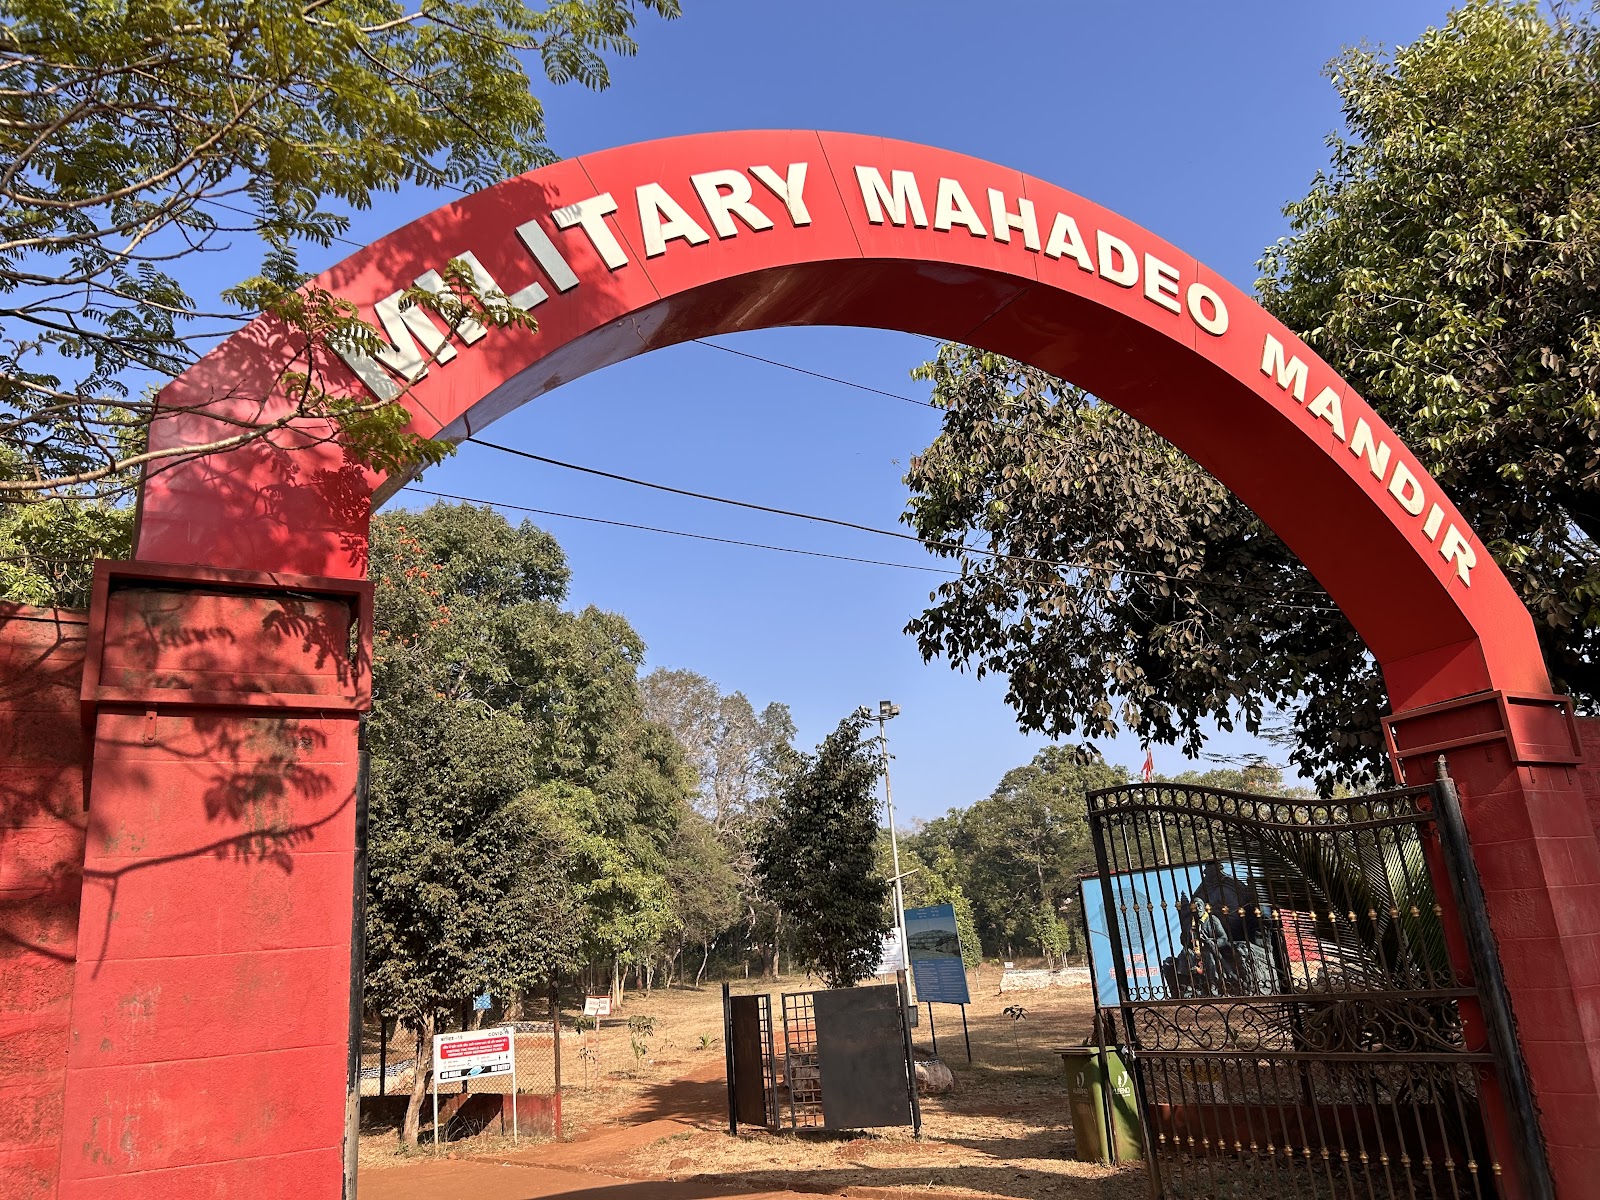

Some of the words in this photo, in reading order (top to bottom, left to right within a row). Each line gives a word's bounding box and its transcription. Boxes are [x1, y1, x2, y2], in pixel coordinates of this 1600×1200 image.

[326, 162, 812, 401] MILITARY
[853, 165, 1229, 336] MAHADEO
[1260, 332, 1477, 588] MANDIR
